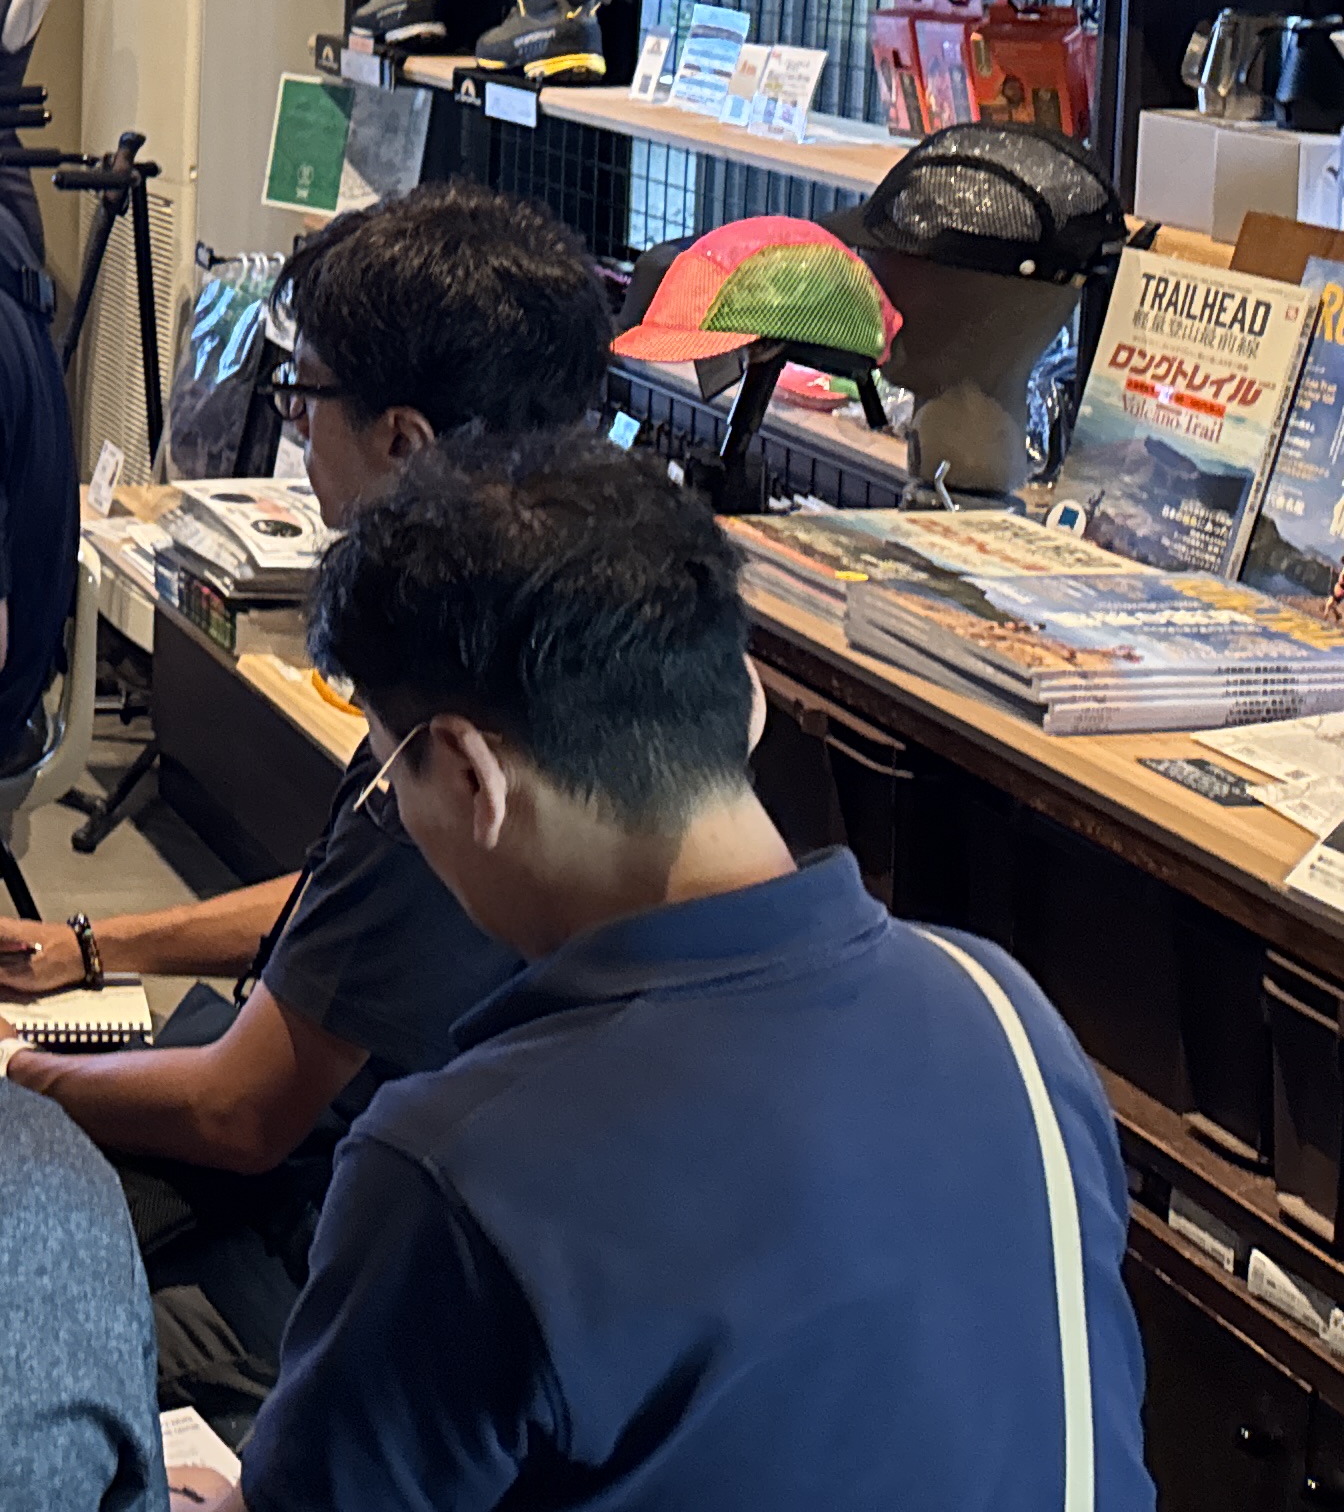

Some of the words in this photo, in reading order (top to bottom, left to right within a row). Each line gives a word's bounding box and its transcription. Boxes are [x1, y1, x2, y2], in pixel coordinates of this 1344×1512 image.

[1139, 272, 1272, 338] TRAILHEAD
[1108, 343, 1263, 407] ロングトレイル
[1121, 393, 1180, 430] Volcano
[1183, 411, 1224, 444] Trail
